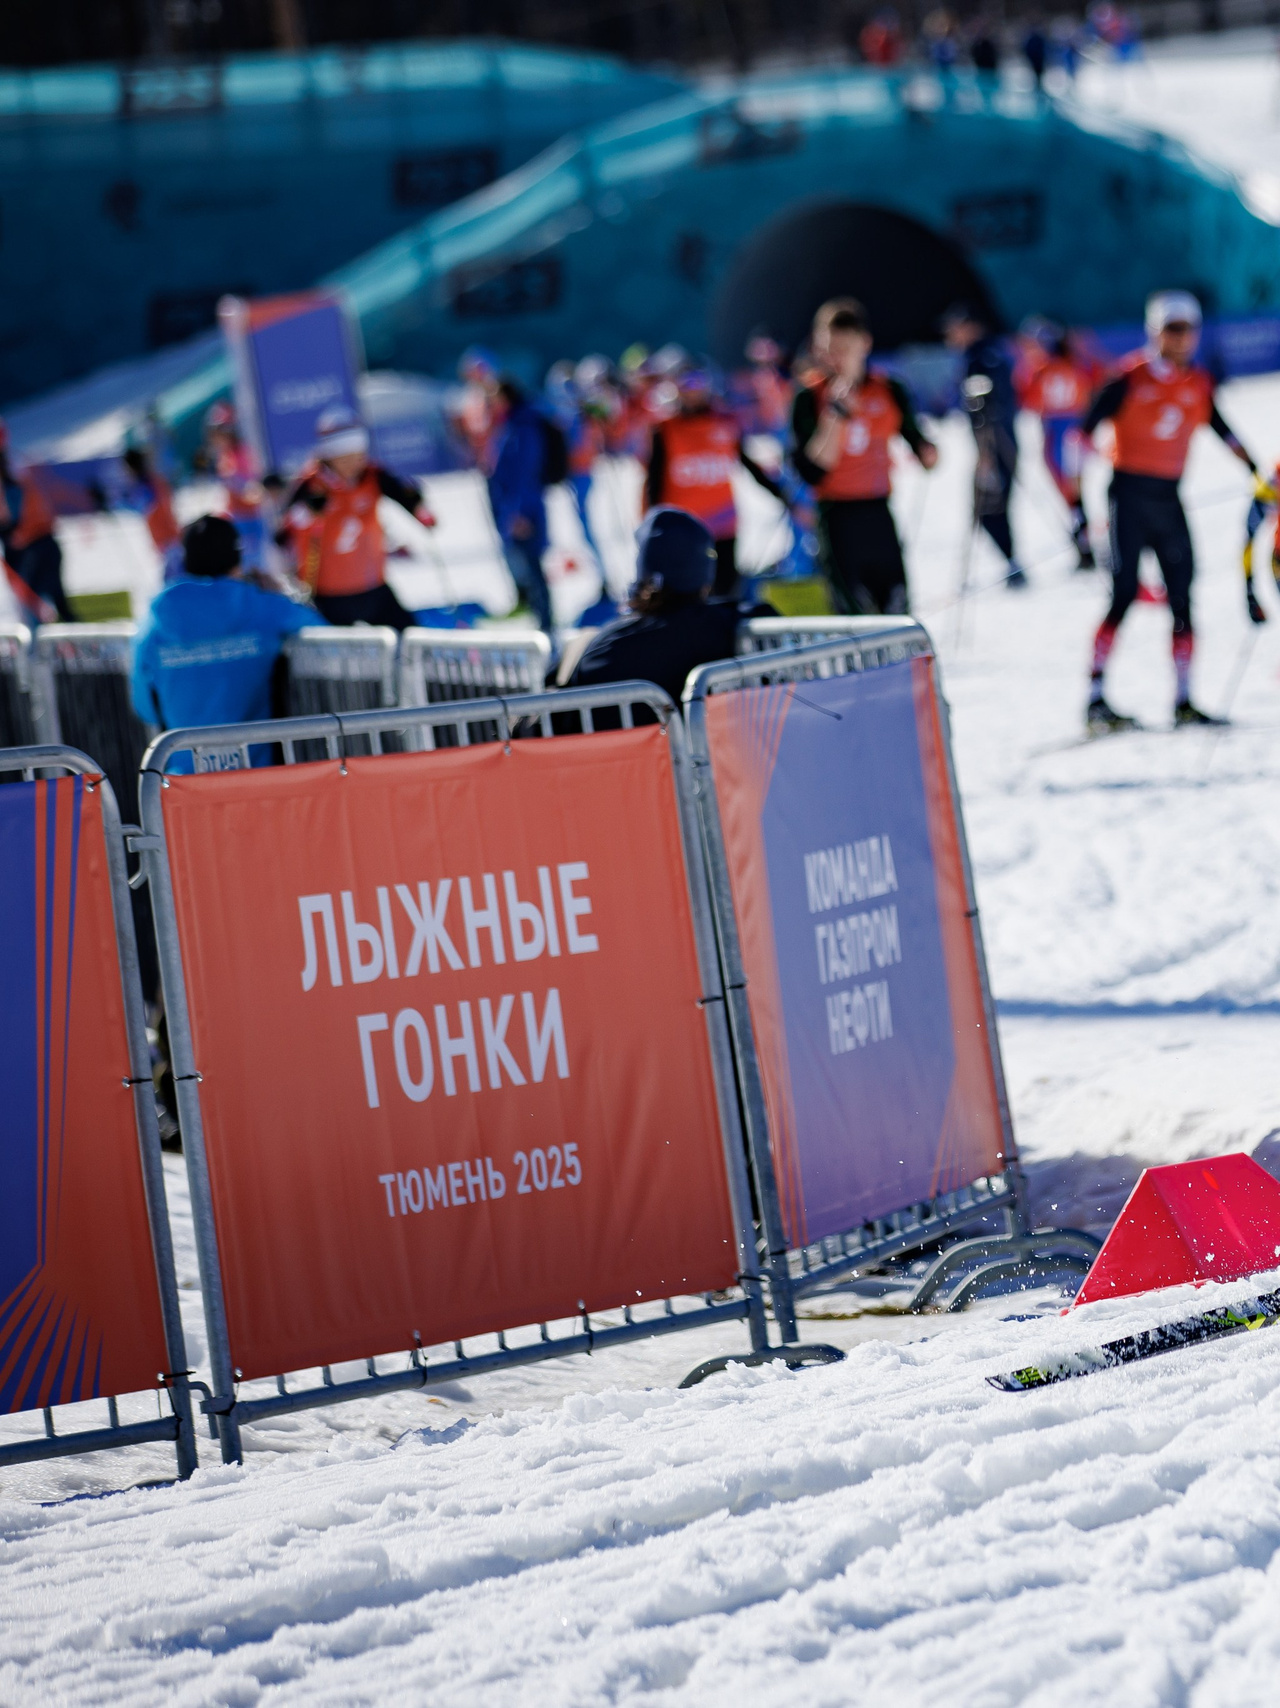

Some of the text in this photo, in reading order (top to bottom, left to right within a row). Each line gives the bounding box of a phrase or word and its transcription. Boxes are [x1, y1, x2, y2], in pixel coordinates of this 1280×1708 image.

[804, 833, 899, 914] КОМАНДА
[298, 861, 600, 992] ЛЫЖНЫЕ
[815, 903, 902, 985] ГАЗПРОМ
[357, 987, 570, 1109] ГОНКИ
[825, 978, 894, 1055] НЕФТИ
[378, 1142, 583, 1218] ТЮМЕНЬ 2025
